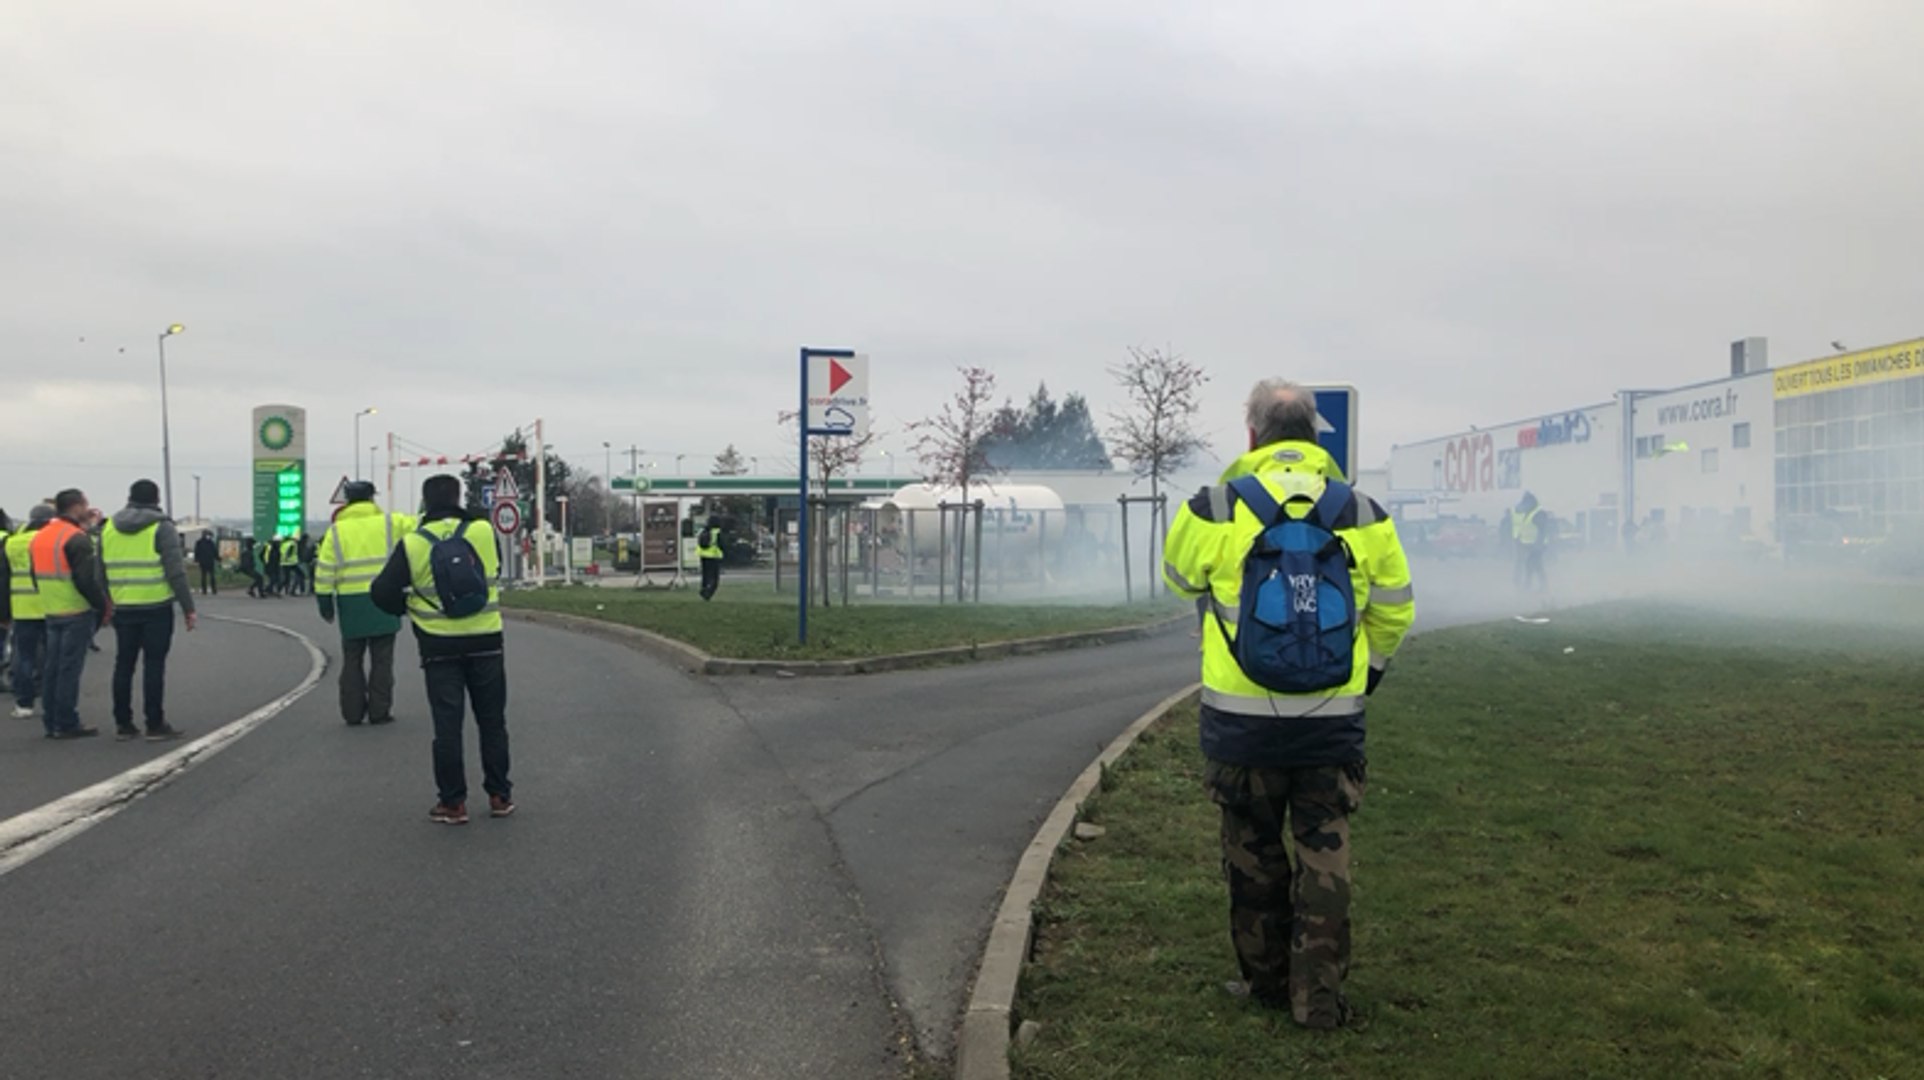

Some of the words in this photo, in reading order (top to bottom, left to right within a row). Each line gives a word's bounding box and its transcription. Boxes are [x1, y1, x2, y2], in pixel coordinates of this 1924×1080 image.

[1834, 362, 1853, 381] LES
[1657, 387, 1738, 426] www.cora.fr
[1444, 432, 1494, 494] cora
